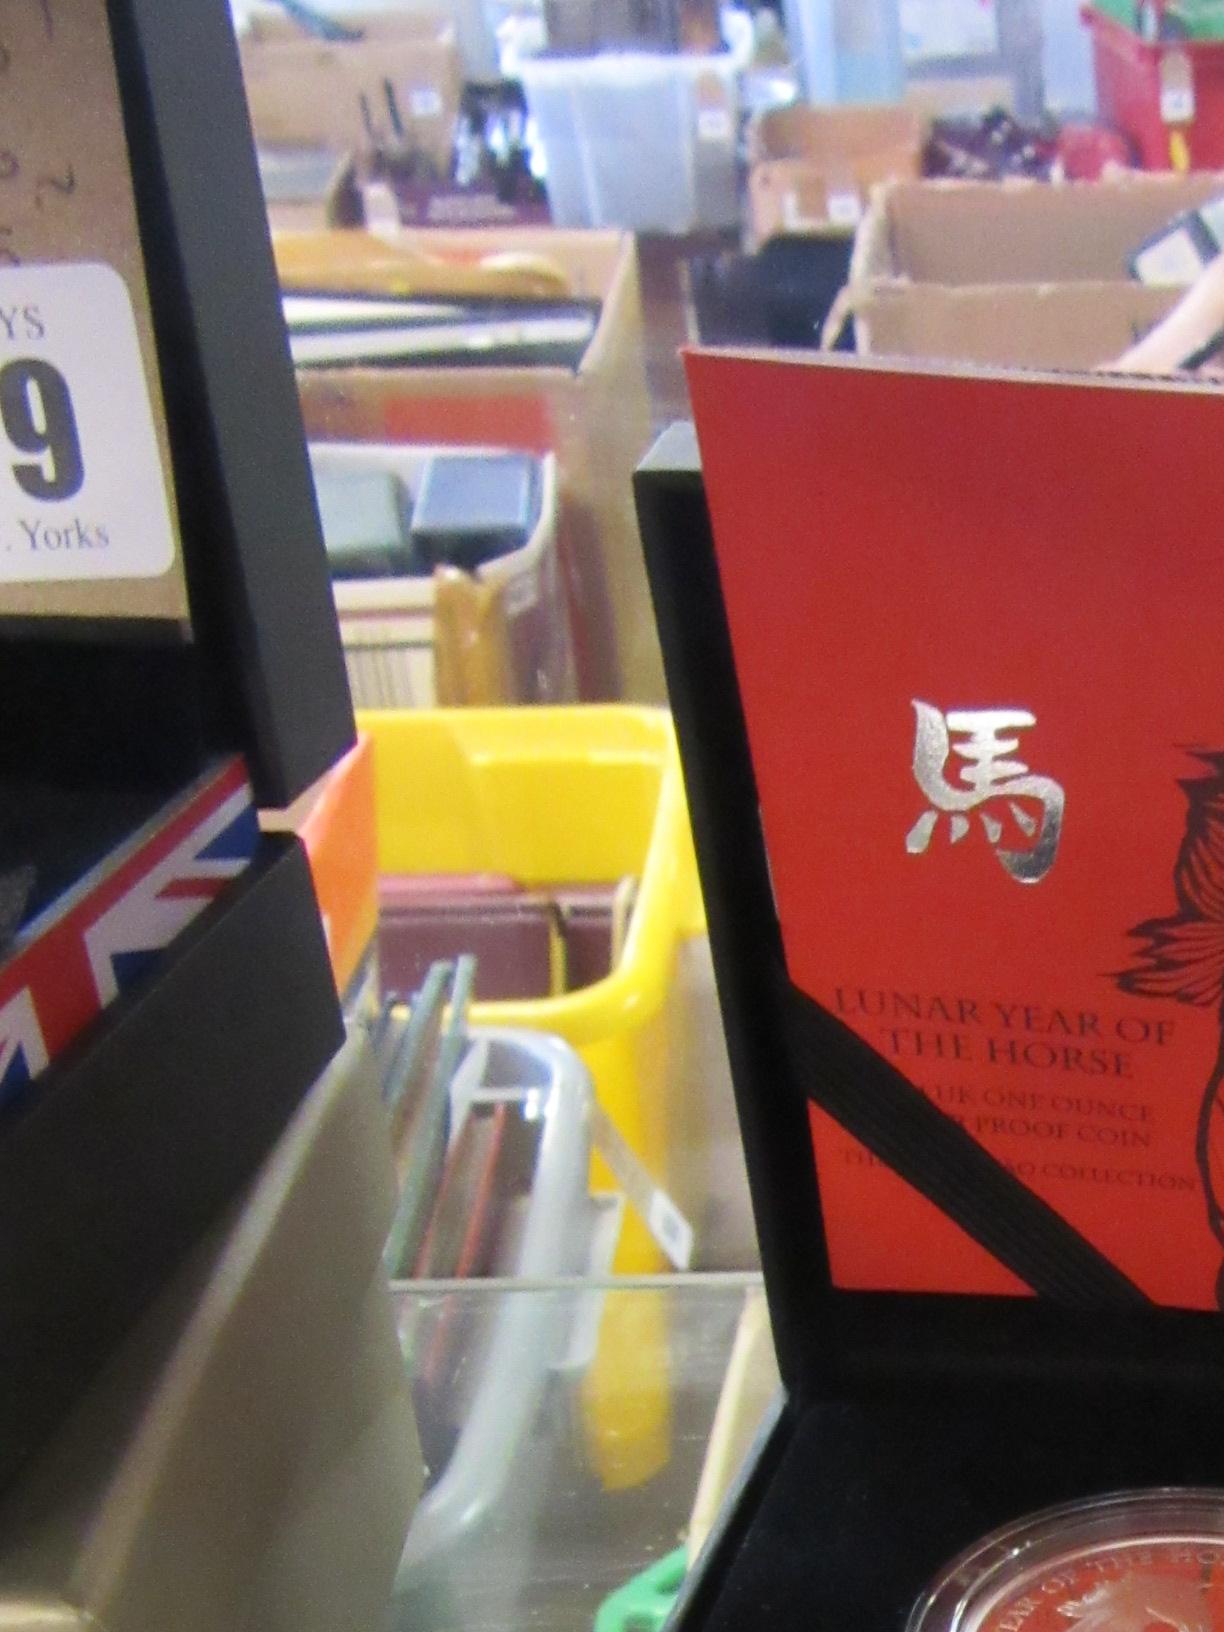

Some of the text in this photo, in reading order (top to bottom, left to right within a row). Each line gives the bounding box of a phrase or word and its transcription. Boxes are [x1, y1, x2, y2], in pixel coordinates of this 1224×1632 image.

[20, 518, 110, 551] Yorks
[906, 698, 1065, 884] 馬
[833, 986, 1176, 1046] LUNAR YEAR OF
[880, 1029, 1133, 1079] THE HORSE
[984, 1088, 1042, 1112] ONE
[1050, 1096, 1152, 1123] OUNCE
[974, 1117, 1074, 1140] PROOF
[1076, 1124, 1150, 1148] COIN
[1040, 1163, 1197, 1192] COLLECTION
